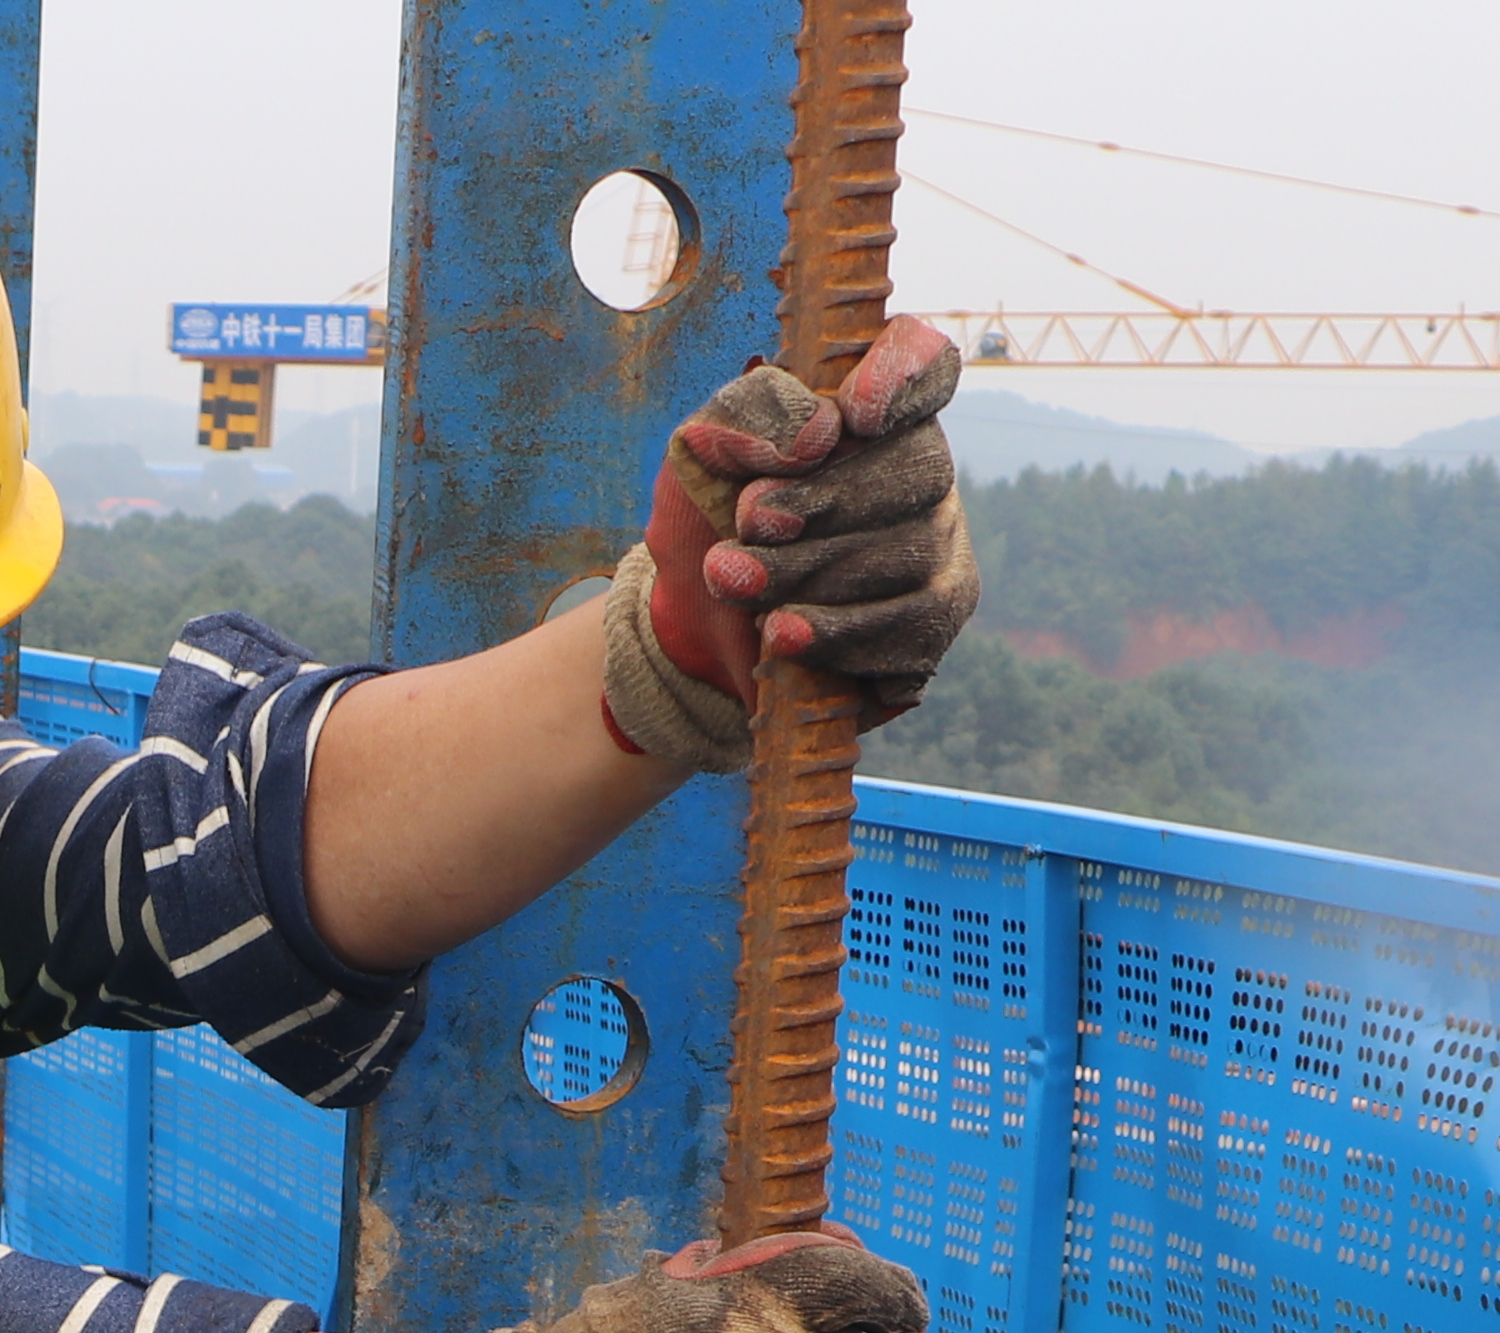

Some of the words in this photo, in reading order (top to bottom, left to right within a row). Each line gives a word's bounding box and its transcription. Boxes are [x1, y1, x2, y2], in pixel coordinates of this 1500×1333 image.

[221, 312, 365, 349] 中铁十一局集团
